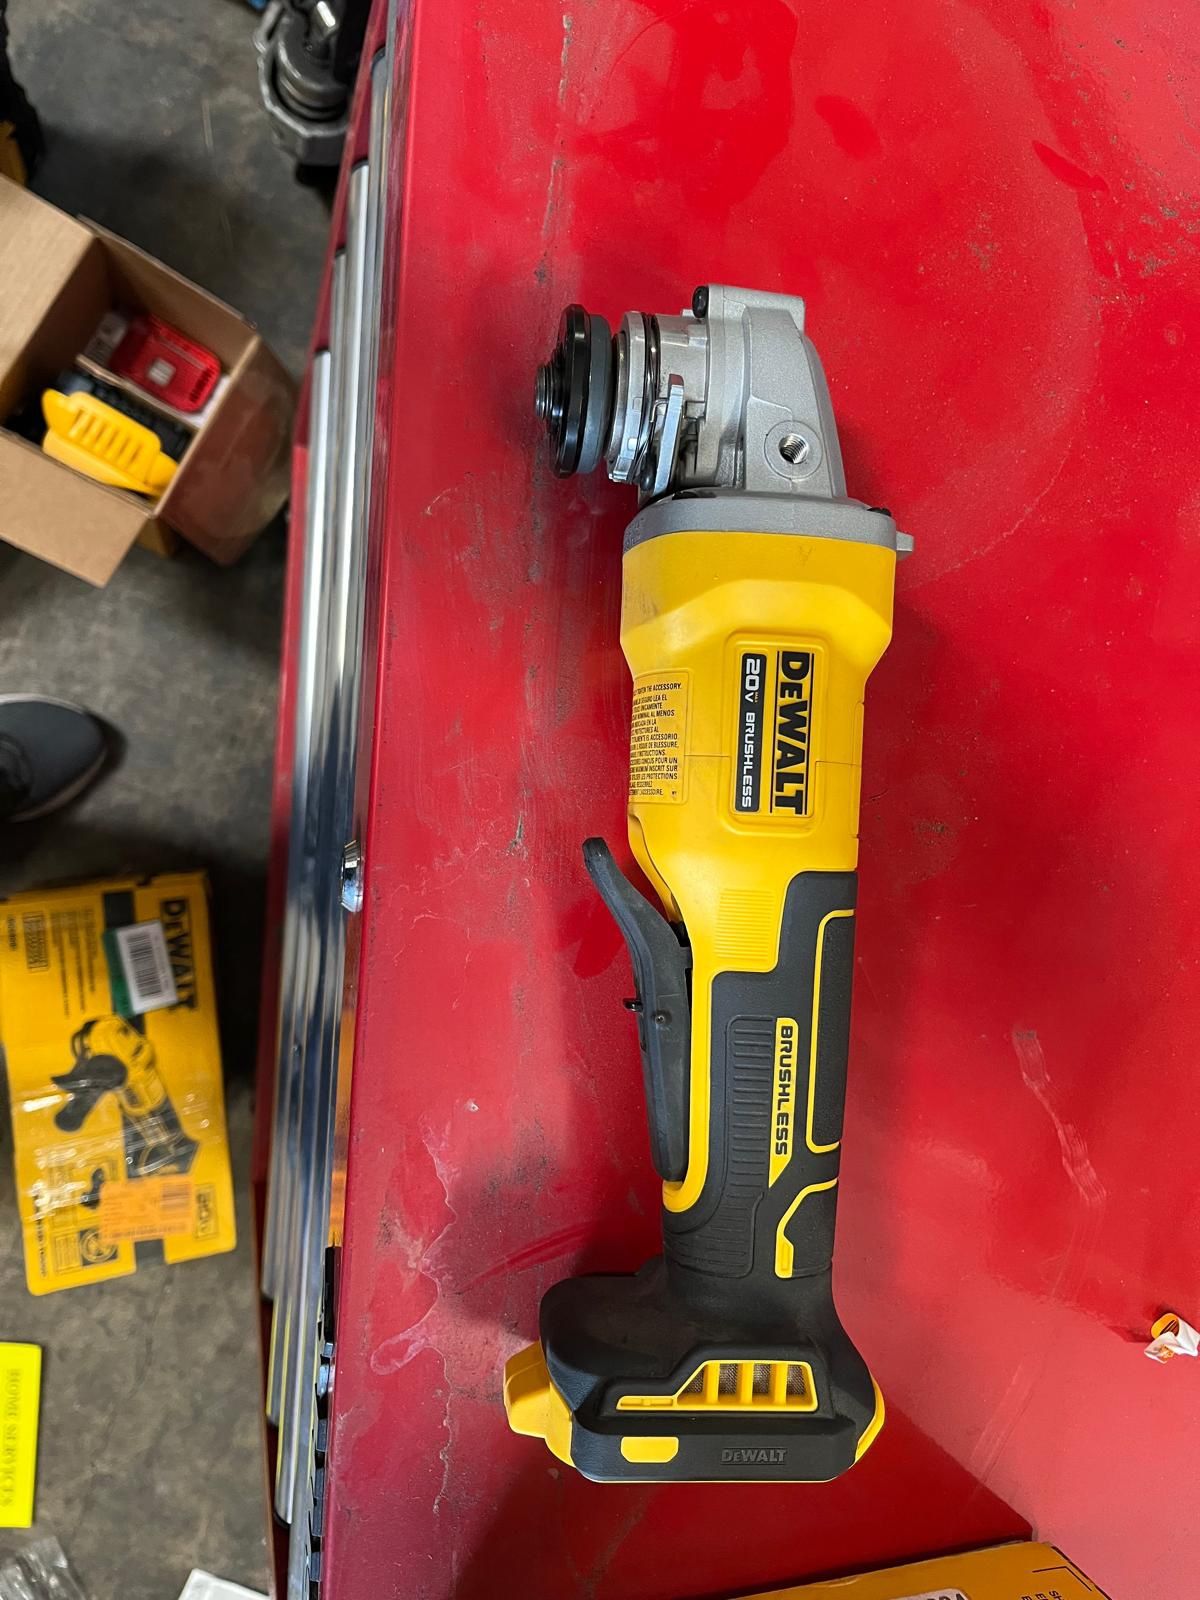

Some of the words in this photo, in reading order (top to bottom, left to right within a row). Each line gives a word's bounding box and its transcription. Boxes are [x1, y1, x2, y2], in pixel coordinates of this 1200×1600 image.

[656, 709, 675, 717] MENOS
[742, 712, 755, 808] BRUSHLESS
[774, 651, 811, 815] DEWALT
[775, 1025, 794, 1156] BRUSHLESS
[721, 1448, 787, 1463] DEWALT
